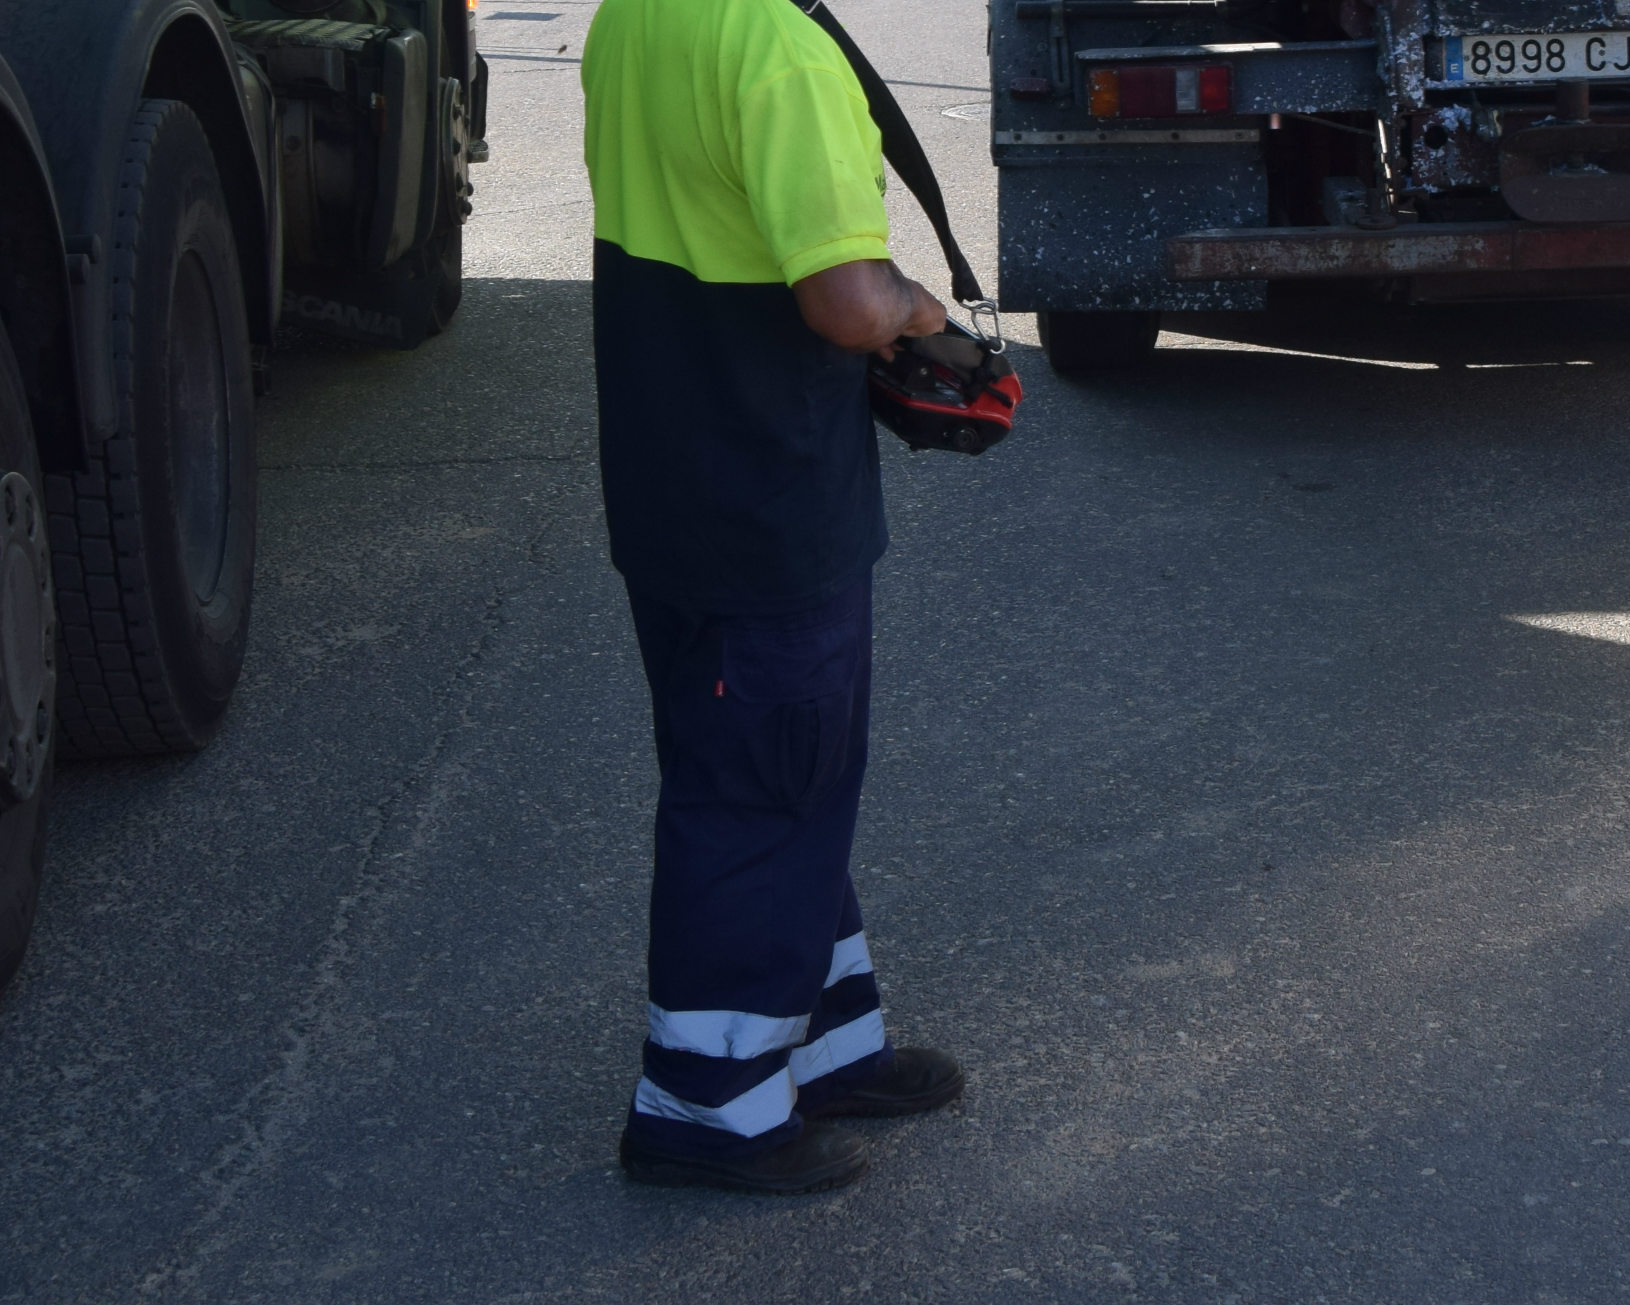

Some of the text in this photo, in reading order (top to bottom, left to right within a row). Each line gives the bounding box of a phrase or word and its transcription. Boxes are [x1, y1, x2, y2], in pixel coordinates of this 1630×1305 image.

[1450, 62, 1459, 73] E
[1471, 38, 1566, 75] 8998
[282, 289, 404, 340] SCANIA
